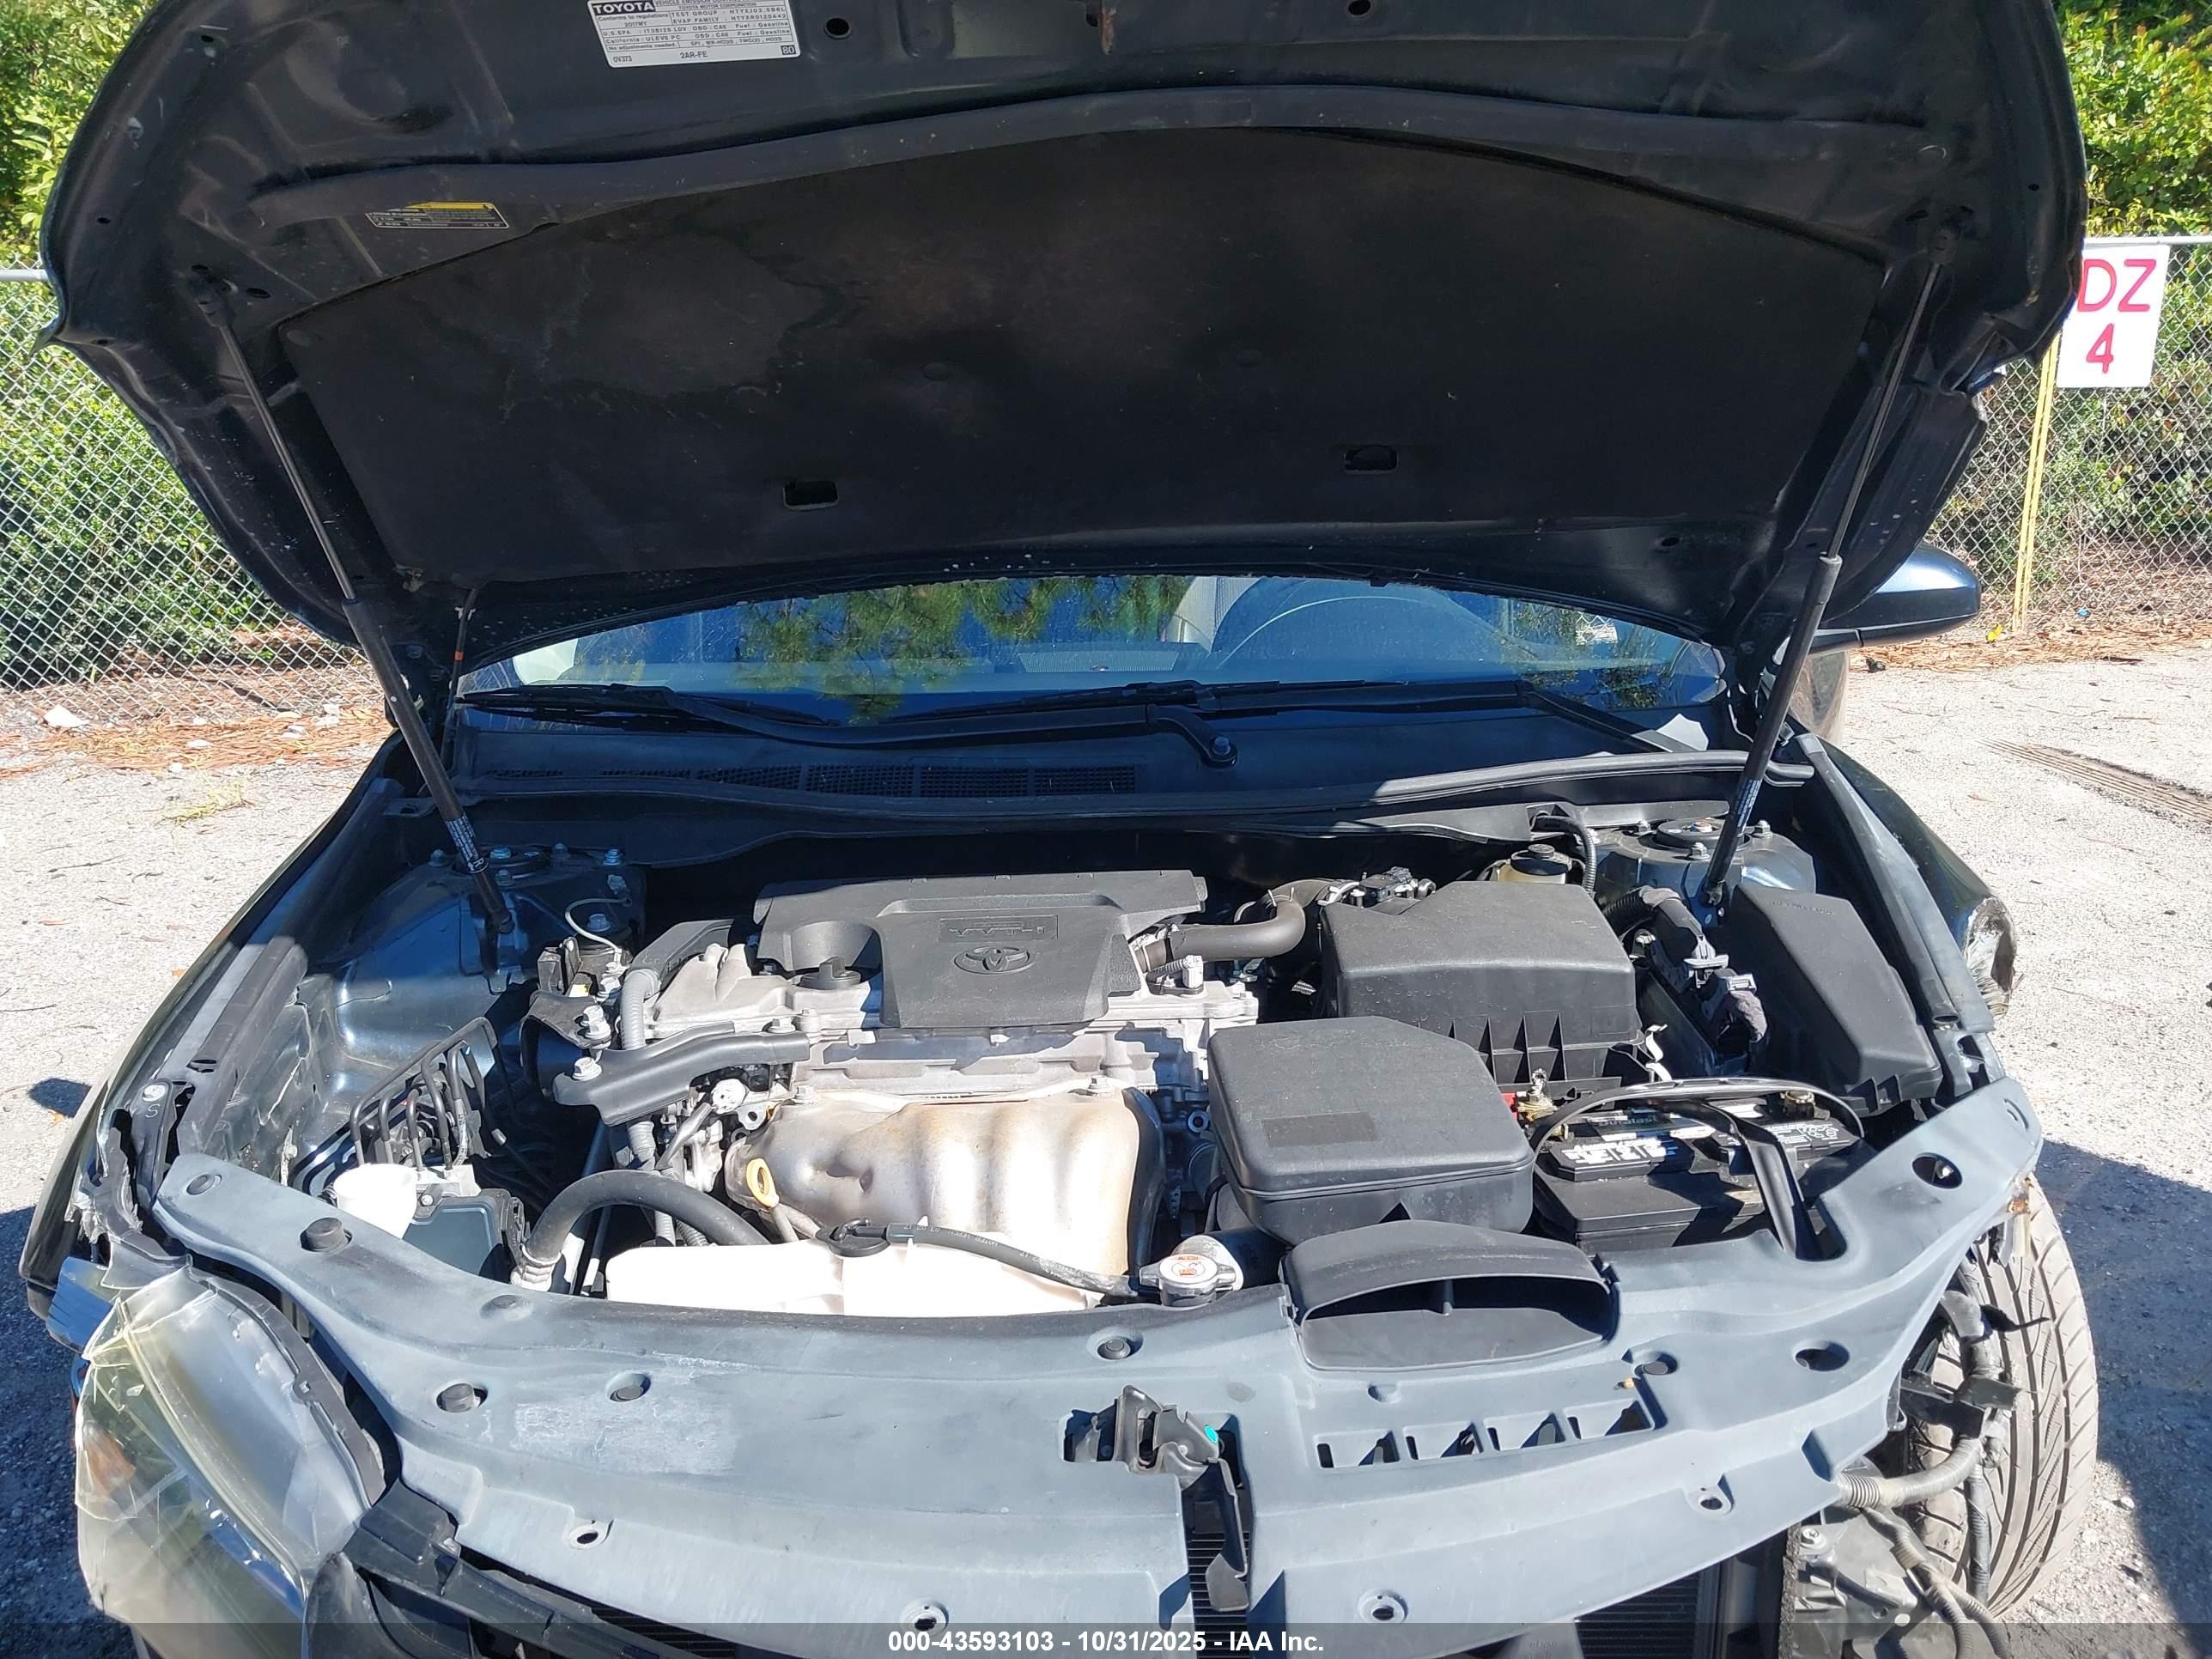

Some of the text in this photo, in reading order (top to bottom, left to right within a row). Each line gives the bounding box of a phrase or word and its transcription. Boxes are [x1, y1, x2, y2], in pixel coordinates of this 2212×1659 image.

[592, 2, 654, 14] TOYOTA
[680, 51, 708, 59] 2AR-FE
[2076, 258, 2157, 313] DZ
[2086, 323, 2115, 374] 4
